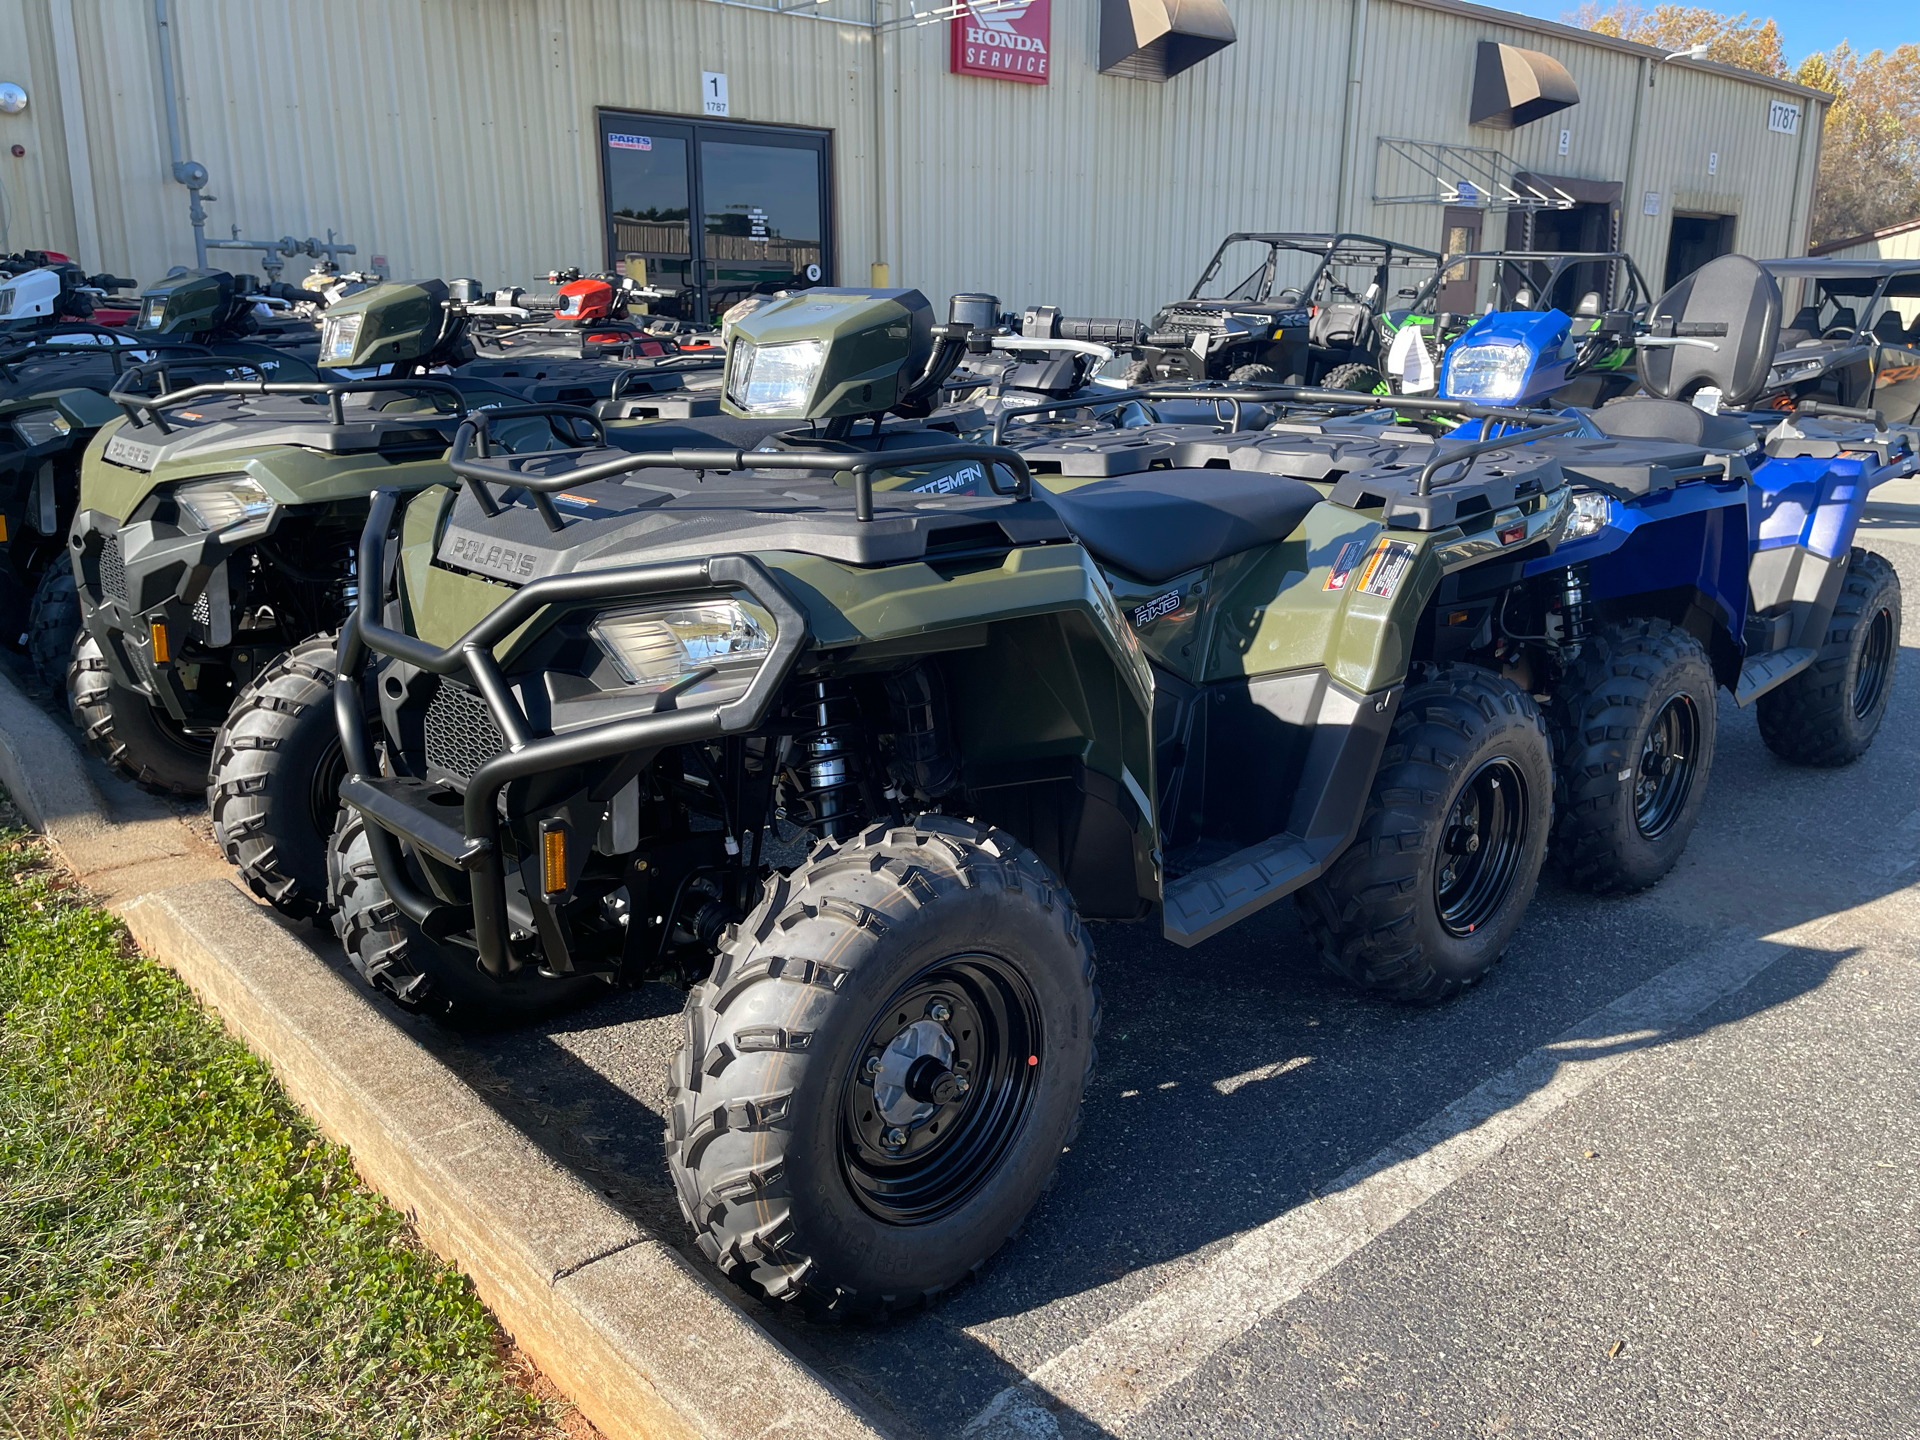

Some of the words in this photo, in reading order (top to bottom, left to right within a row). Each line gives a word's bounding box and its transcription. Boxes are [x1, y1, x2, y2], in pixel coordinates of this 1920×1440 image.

[966, 27, 1047, 54] HONDA
[966, 47, 1047, 74] SERVICE
[710, 77, 718, 97] 1
[706, 101, 727, 112] 1787
[1772, 105, 1797, 130] 1787
[609, 134, 651, 145] PARTS
[1561, 132, 1568, 145] 2
[1283, 313, 1307, 322] XP
[450, 537, 537, 577] POLARIS
[1136, 595, 1180, 627] AWD
